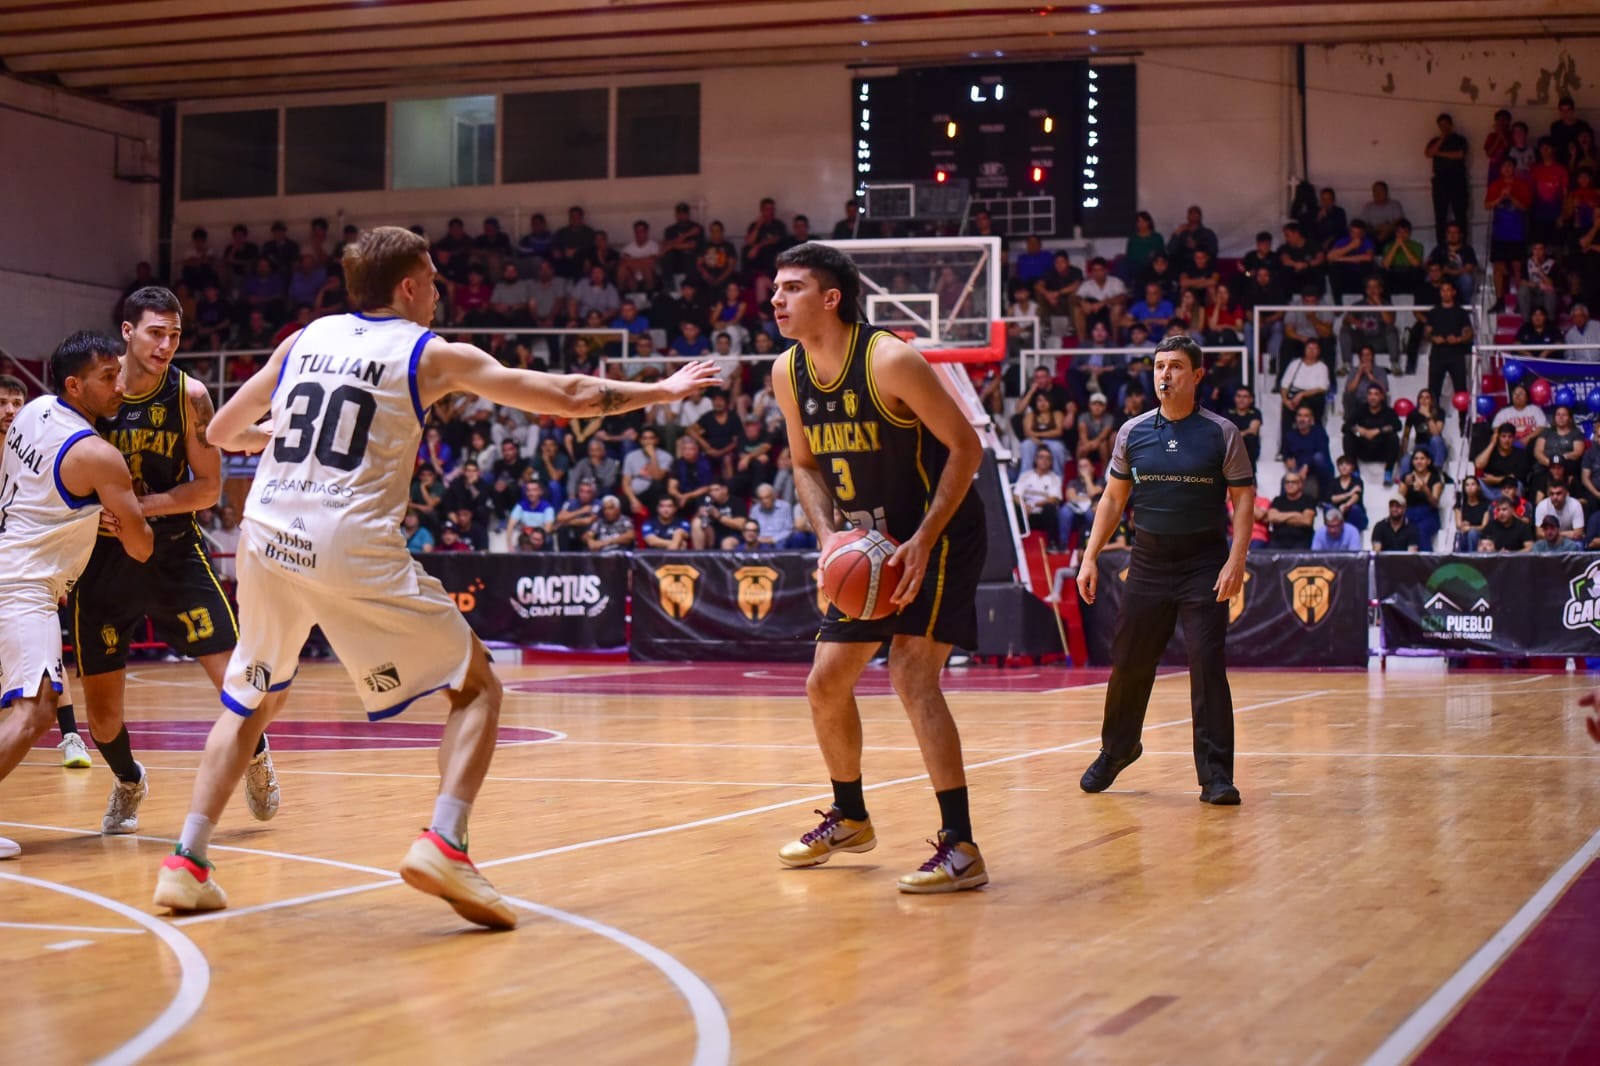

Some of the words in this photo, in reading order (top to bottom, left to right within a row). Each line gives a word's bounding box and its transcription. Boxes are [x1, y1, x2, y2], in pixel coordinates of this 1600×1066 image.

[299, 354, 386, 387] TULIAN
[273, 382, 377, 472] 30
[279, 480, 354, 498] SANTIAGO
[831, 458, 856, 501] 3
[265, 542, 317, 569] Bristol
[271, 531, 313, 551] Abba
[516, 574, 602, 605] CACTUS
[177, 607, 215, 643] 13
[1446, 615, 1493, 632] PUEBLO
